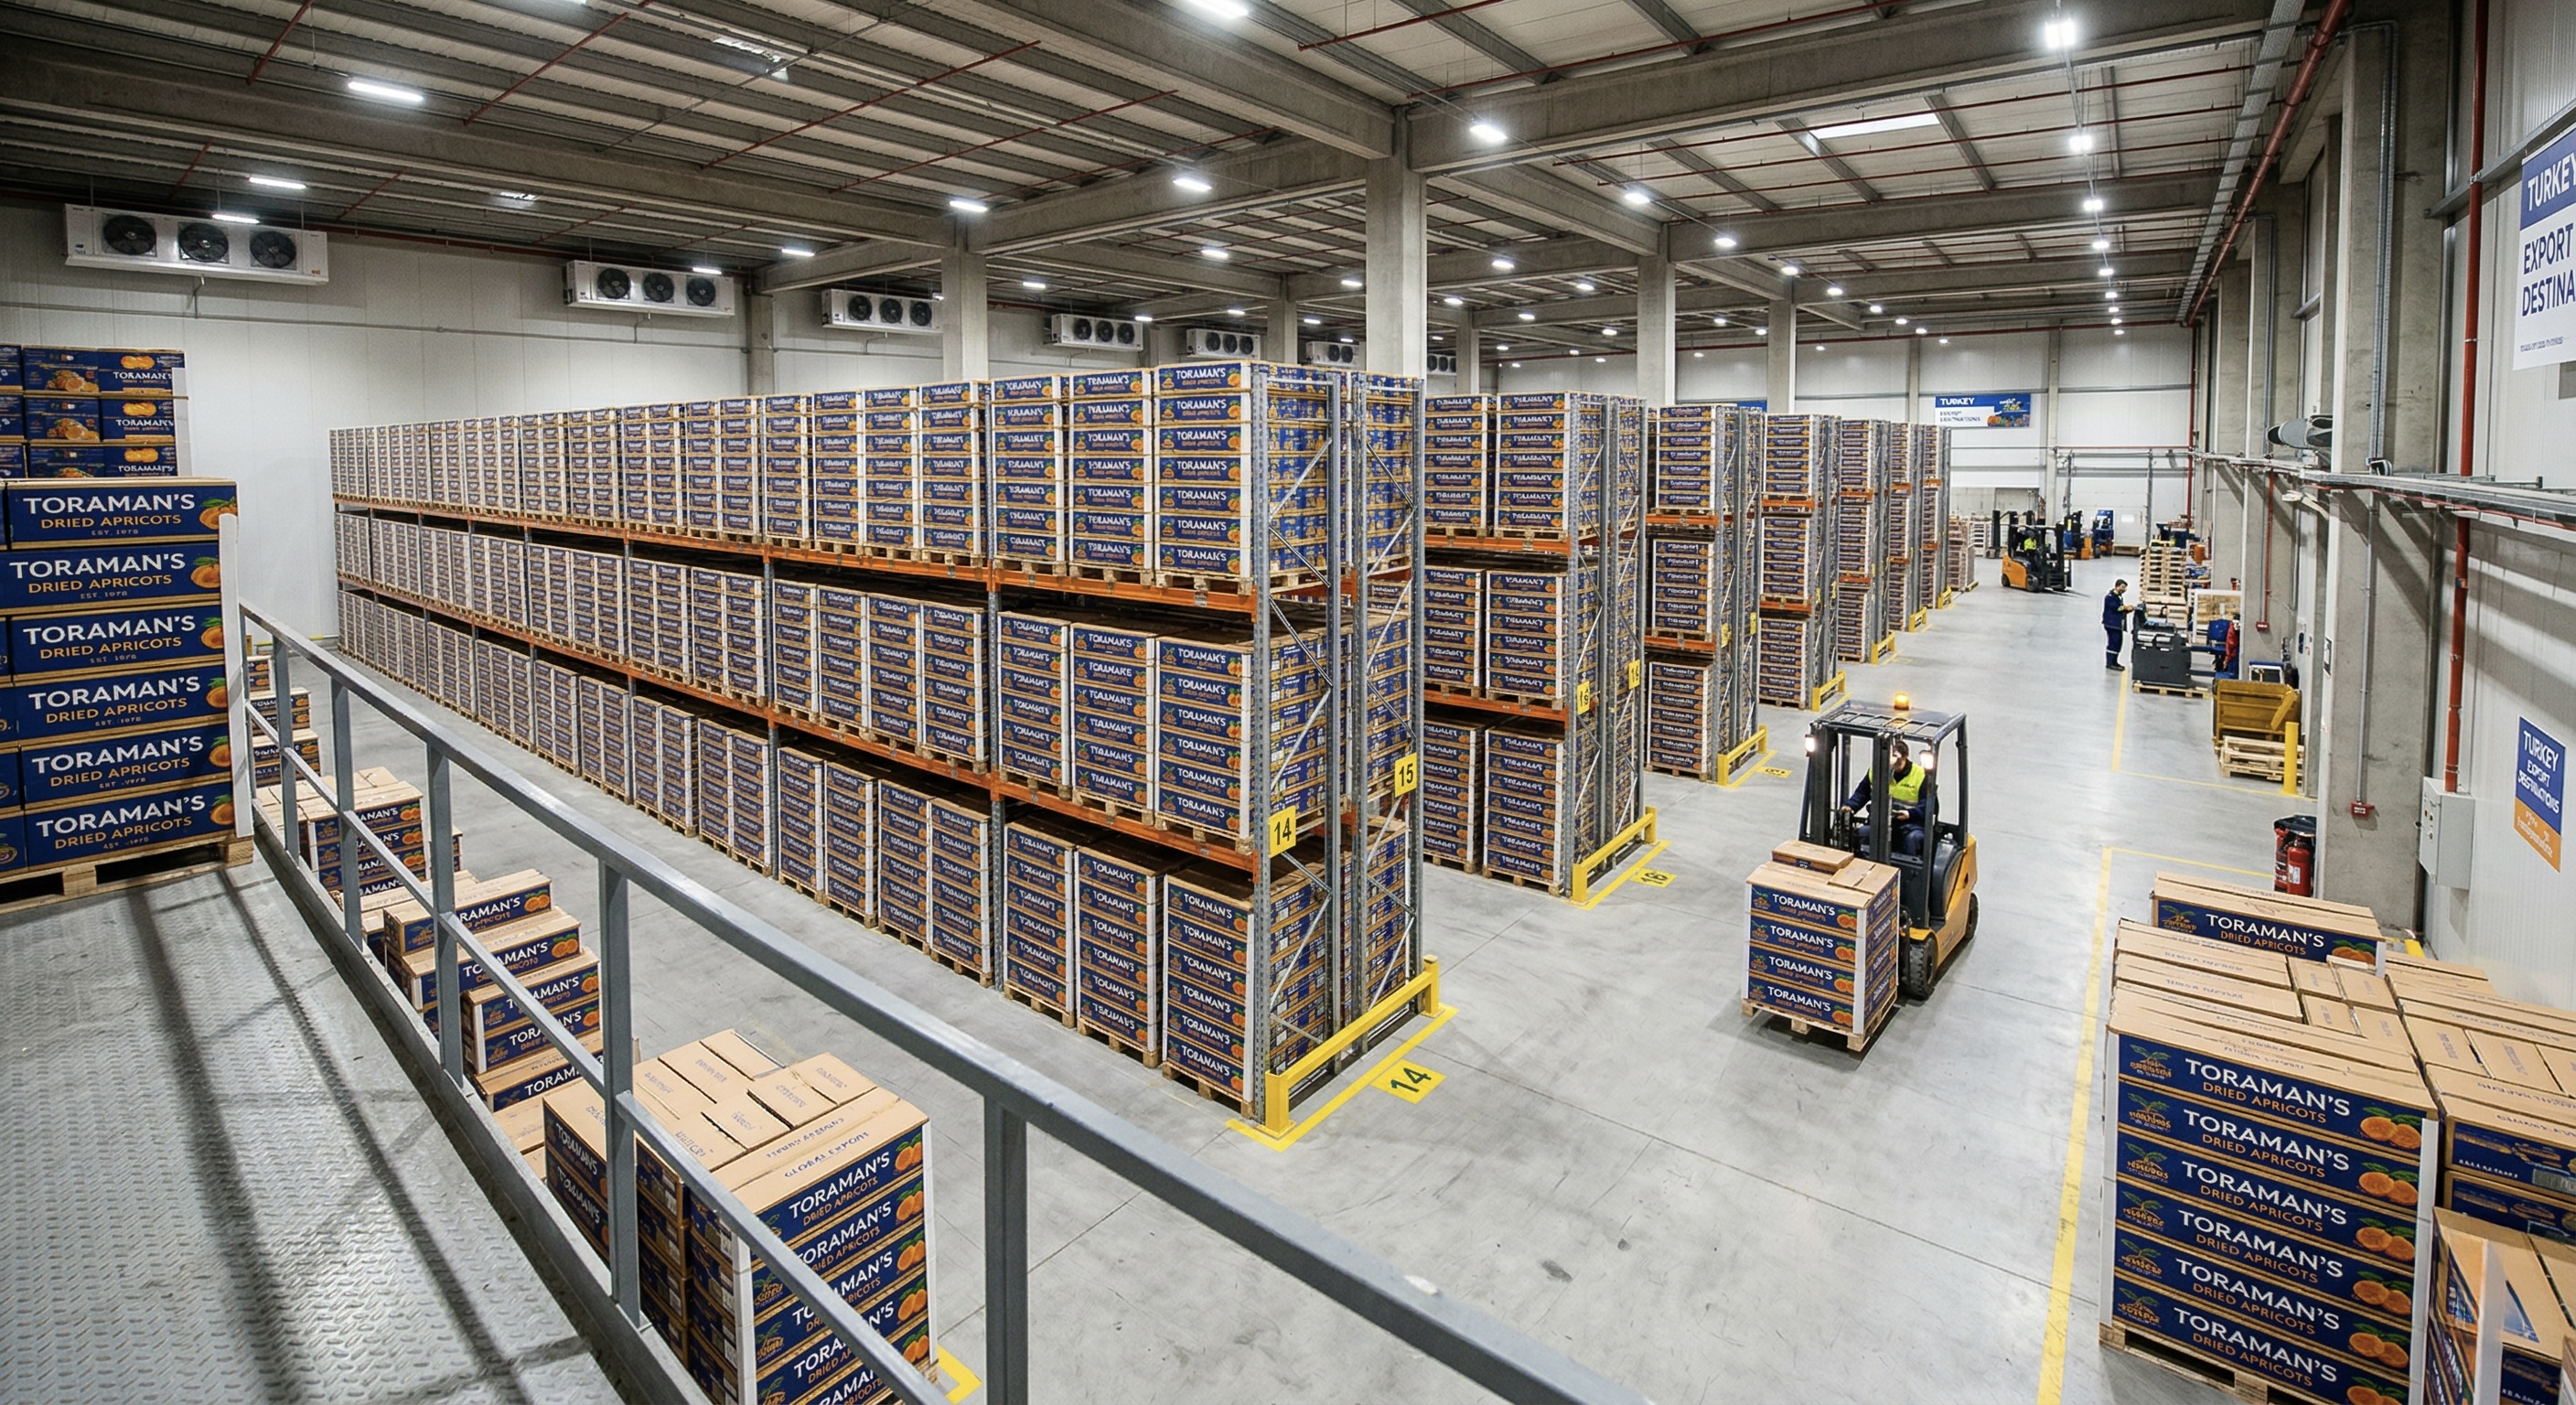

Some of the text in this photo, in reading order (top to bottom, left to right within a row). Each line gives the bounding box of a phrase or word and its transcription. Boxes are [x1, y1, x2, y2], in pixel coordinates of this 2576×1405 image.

[2524, 222, 2574, 276] EXPORT
[23, 494, 195, 515] TORAMAN'S
[41, 514, 182, 529] DRIED APRICOTS
[9, 552, 186, 579] TORAMAN'S
[28, 574, 172, 594] DRIED APRICOTS
[23, 616, 196, 645] TORAMAN'S
[39, 637, 182, 660] DRIED APRICOTS
[28, 676, 201, 710] TORAMAN'S
[46, 698, 188, 724] DRIED APRICOTS
[32, 736, 203, 774] TORAMAN'S
[2524, 730, 2560, 772] TURKEY
[50, 757, 190, 788] DRIED APRICOTS
[1399, 763, 1413, 787] 15
[36, 795, 206, 838] TORAMAN'S
[55, 817, 192, 850] DRIED APRICOTS
[1274, 818, 1292, 845] 14
[460, 897, 521, 922] RAMAN'S
[1772, 894, 1836, 916] TORAMAN'S
[1770, 925, 1834, 949] TORAMAN'S
[2206, 914, 2324, 948] TORAMAN'S
[2221, 930, 2306, 956] DRIED APRICOTS
[1769, 956, 1833, 981] TORAMAN'S
[1767, 986, 1831, 1012] TORAMAN'S
[1390, 1067, 1432, 1093] 14
[2185, 1057, 2351, 1117] TORAMAN'S
[2203, 1082, 2326, 1124] DRIED APRICOTS
[2184, 1110, 2350, 1171] TORAMAN'S
[2203, 1133, 2325, 1178] DRIED APRICOTS
[789, 1152, 890, 1218] TORAMAN'S
[2182, 1161, 2347, 1226] TORAMAN'S
[2200, 1185, 2324, 1232] DRIED APRICOTS
[835, 1226, 880, 1260] APRICOTS
[2178, 1209, 2344, 1278] TORAMAN'S
[2196, 1234, 2318, 1283] DRIED APRICOTS
[2175, 1258, 2340, 1330] TORAMAN'S
[2193, 1283, 2315, 1335] DRIED APRICOTS
[2174, 1307, 2337, 1382] TORAMAN'S
[2194, 1333, 2313, 1387] DRIED APRICOTS
